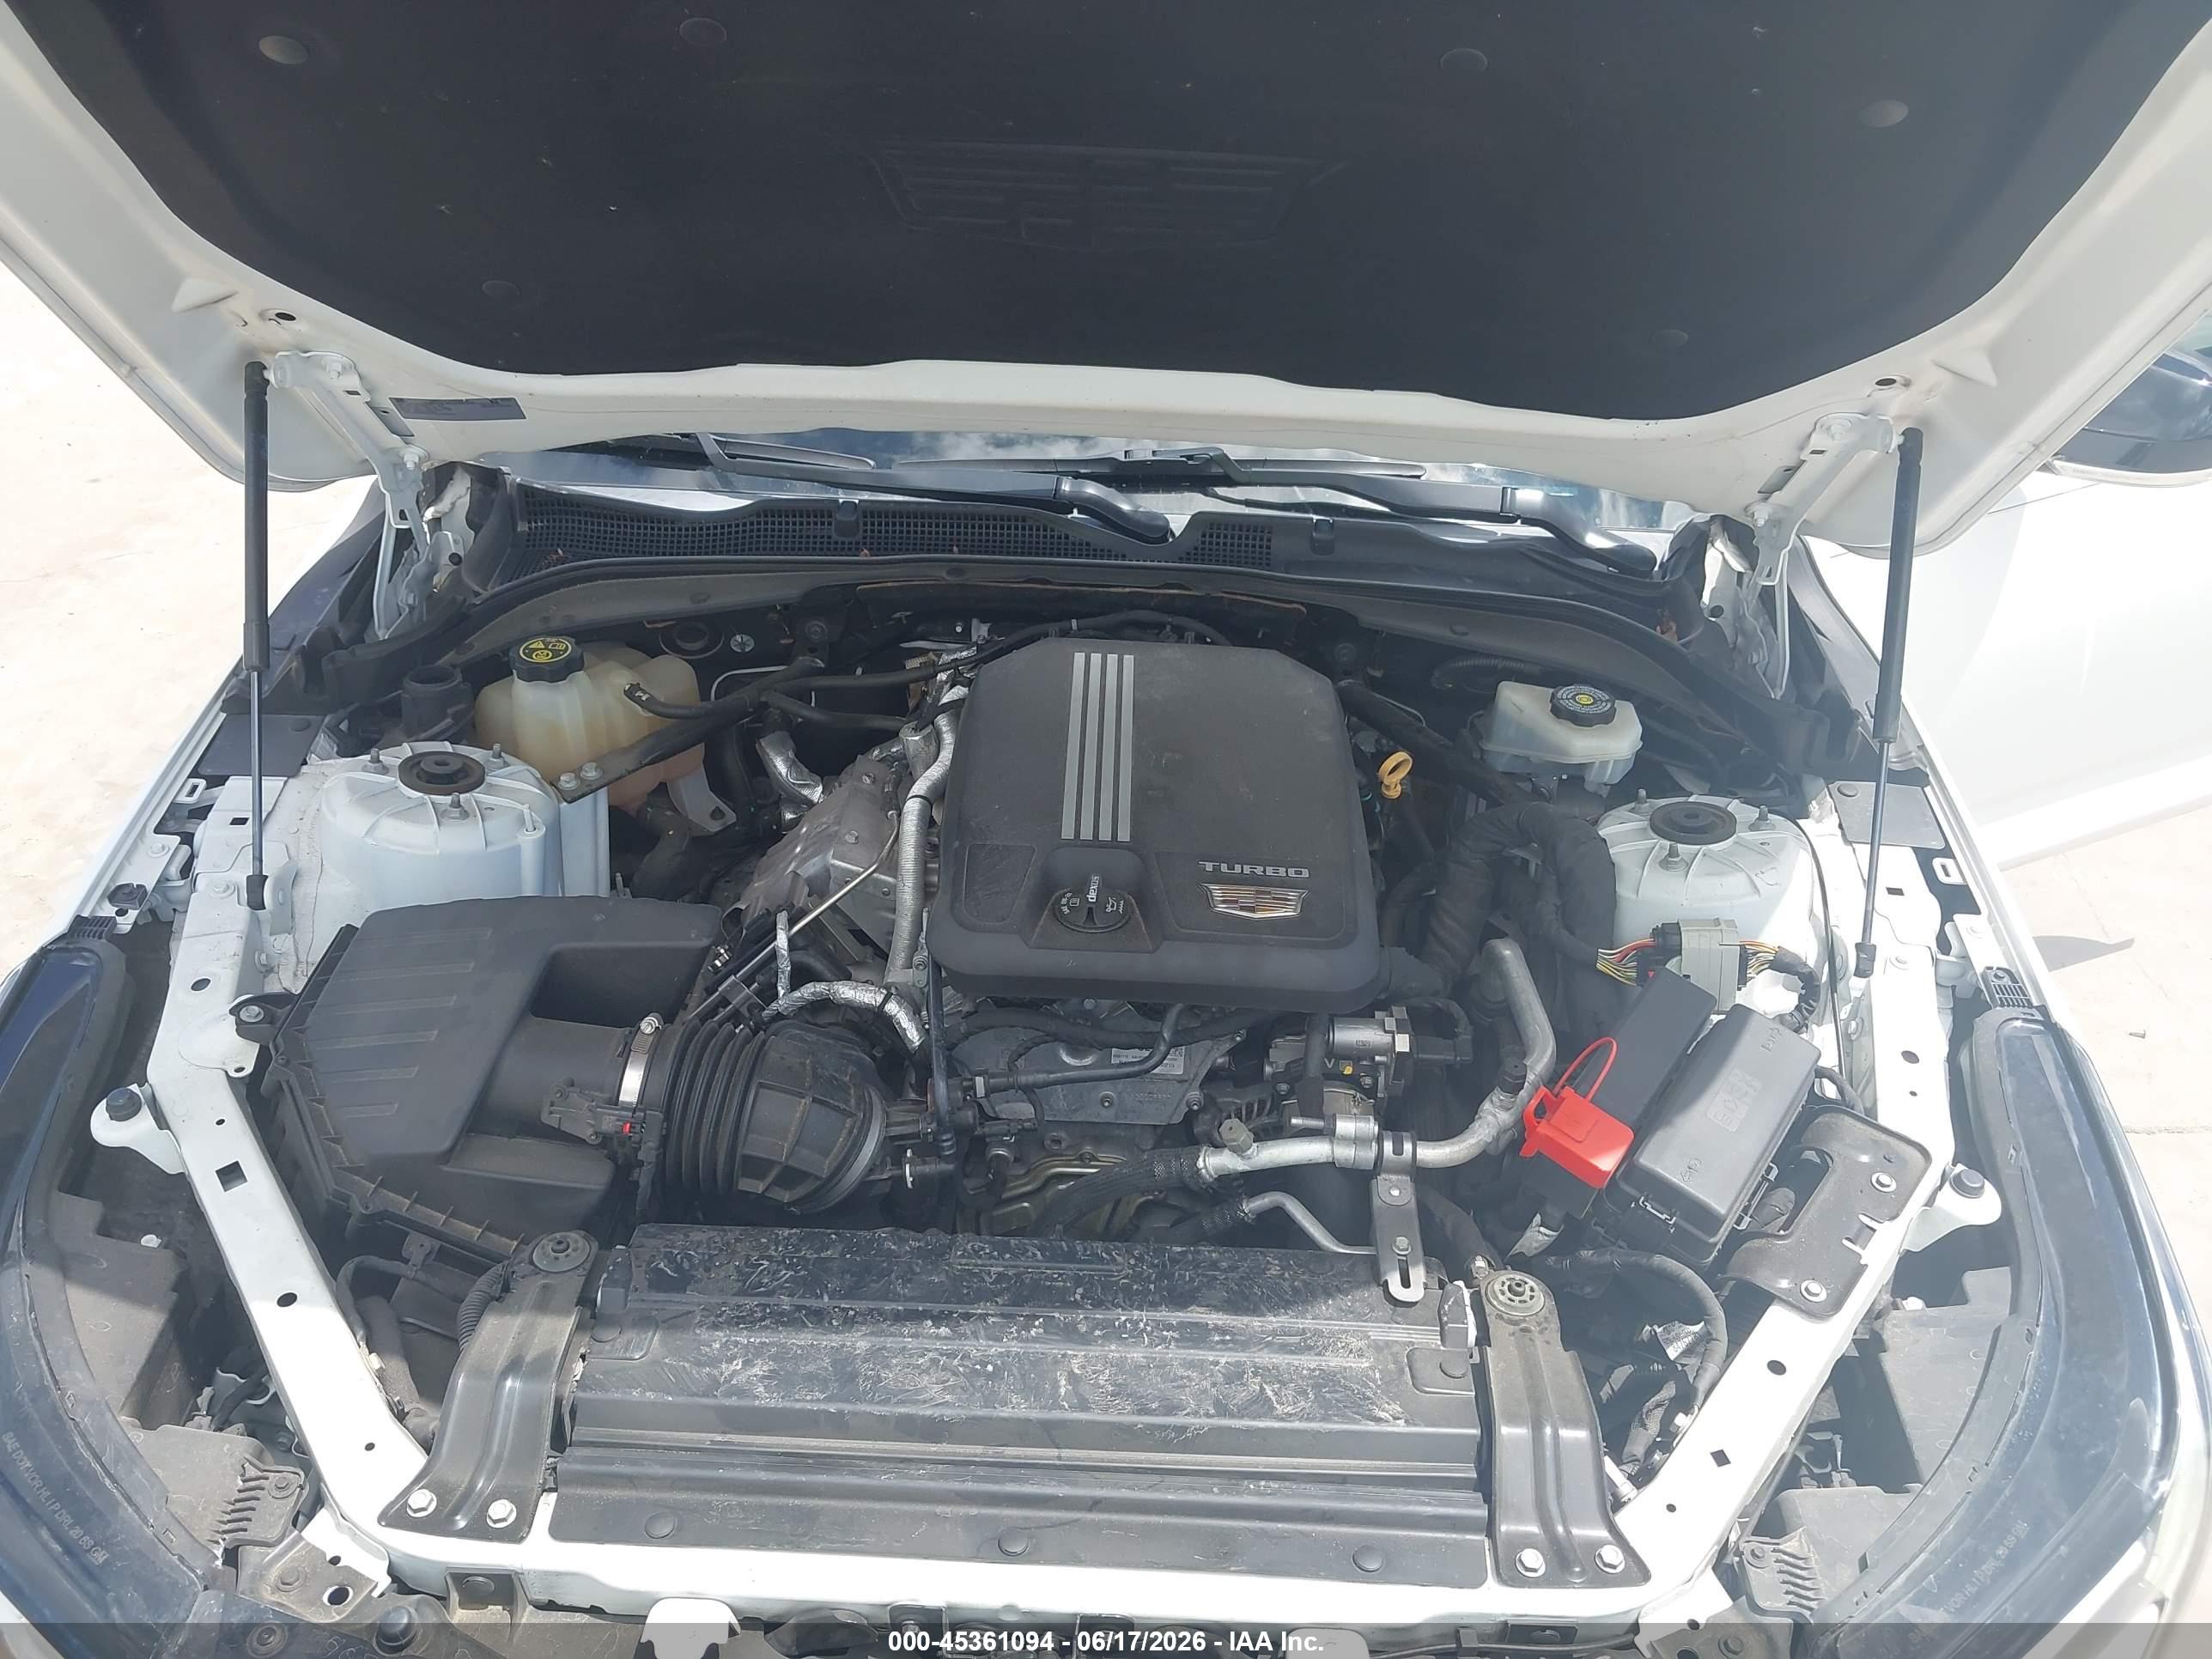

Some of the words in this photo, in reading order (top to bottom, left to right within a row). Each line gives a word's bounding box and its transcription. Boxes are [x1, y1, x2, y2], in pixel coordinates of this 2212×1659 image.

[1199, 860, 1310, 878] TURBO
[1086, 875, 1099, 902] dexos
[2, 1431, 21, 1452] SAE
[12, 1449, 33, 1469] DOT
[25, 1468, 43, 1491] VOR
[37, 1486, 52, 1503] HL
[48, 1503, 61, 1511] P
[55, 1510, 74, 1530] DRL
[70, 1526, 83, 1539] 20
[88, 1547, 109, 1565] GM
